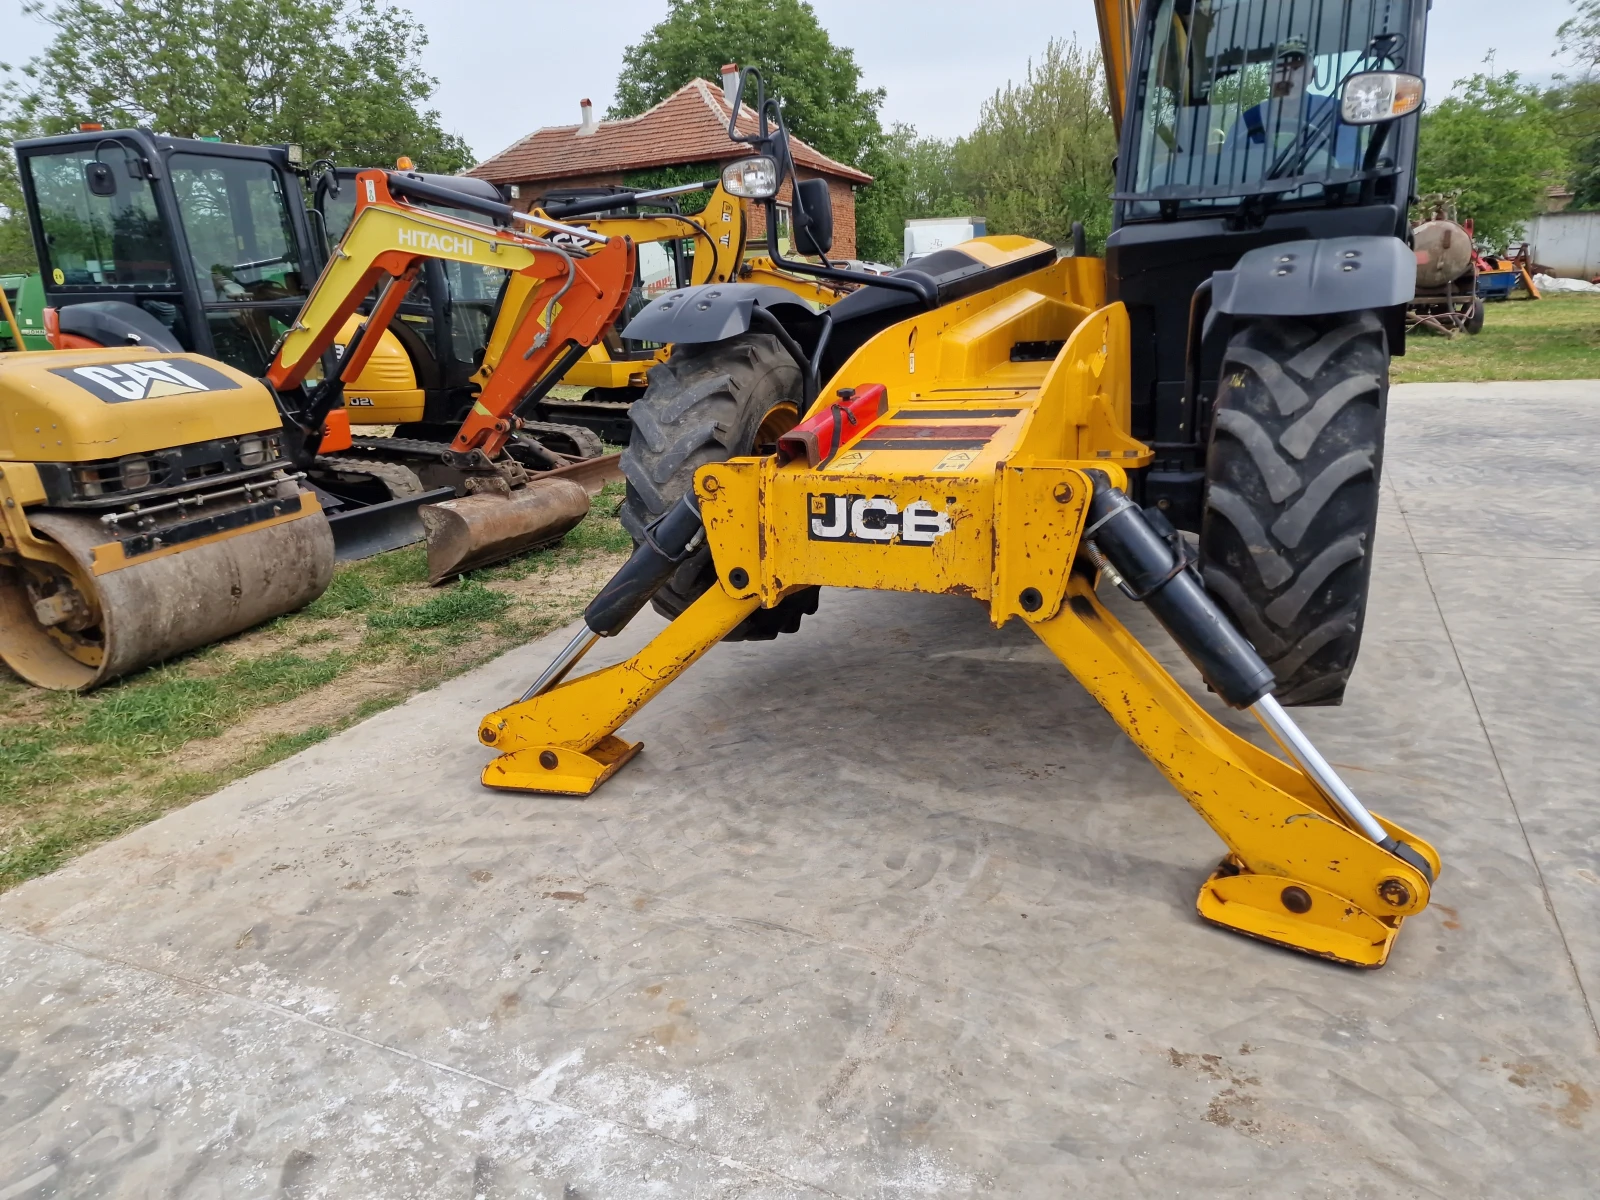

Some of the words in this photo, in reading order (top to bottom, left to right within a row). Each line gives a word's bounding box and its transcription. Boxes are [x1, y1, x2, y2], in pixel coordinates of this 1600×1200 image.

[398, 228, 473, 256] HITACHI
[73, 361, 210, 400] CAT
[811, 497, 951, 542] JCB
